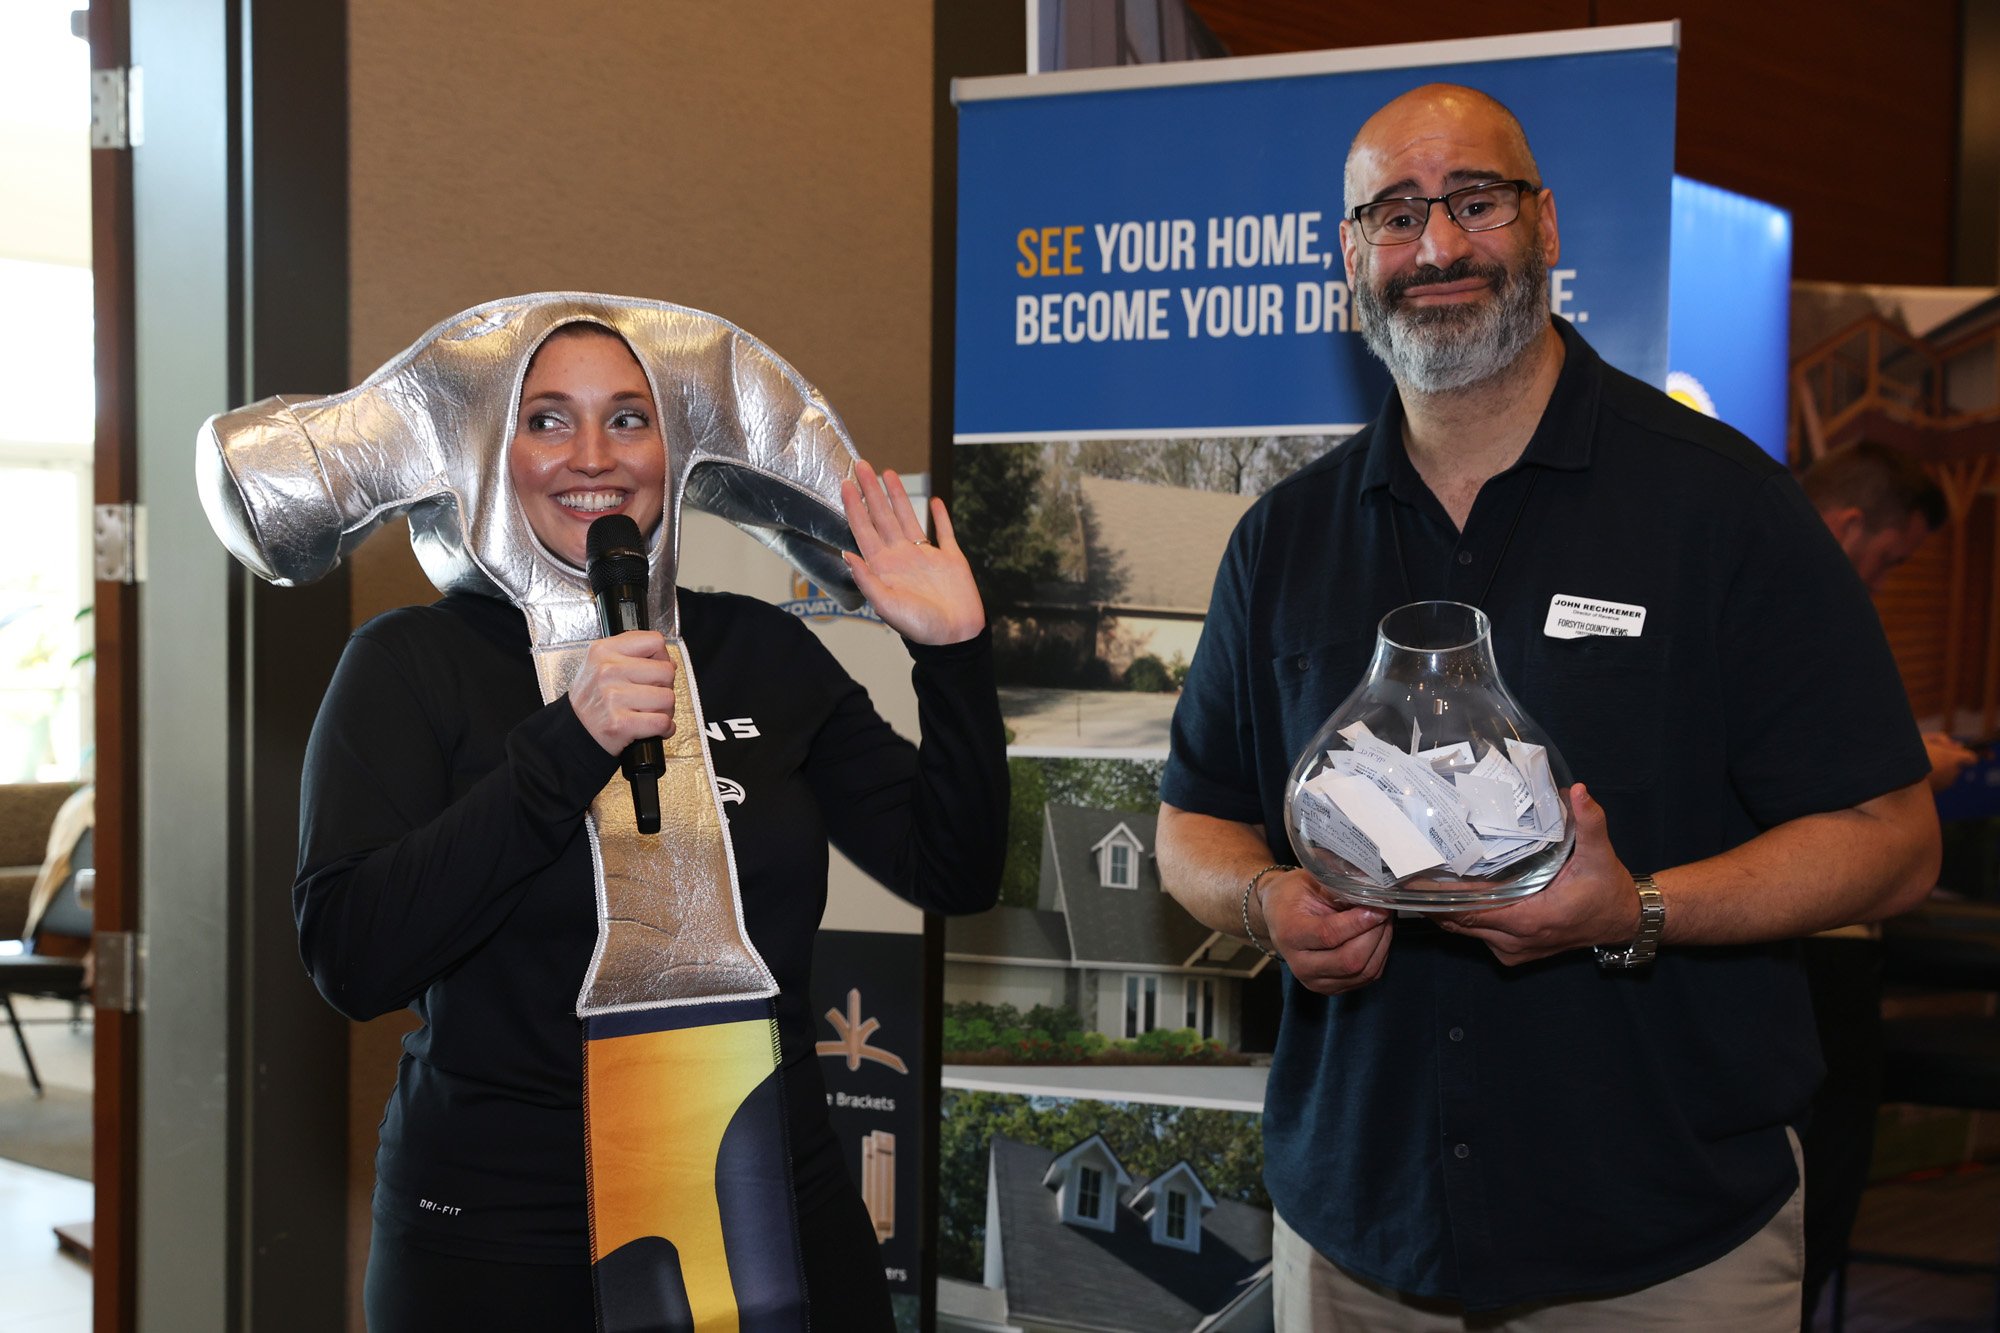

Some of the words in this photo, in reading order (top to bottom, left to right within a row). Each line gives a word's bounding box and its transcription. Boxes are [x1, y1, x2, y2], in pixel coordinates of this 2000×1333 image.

[1016, 226, 1085, 278] SEE
[1094, 219, 1196, 274] YOUR
[1207, 211, 1333, 270] HOME,
[1015, 289, 1170, 346] BECOME
[1180, 284, 1283, 339] YOUR
[1554, 600, 1581, 609] JOHN
[1583, 604, 1642, 618] RECHKEMER
[1557, 618, 1585, 630] FORSYTH
[1585, 622, 1610, 634] COUNTY
[1610, 626, 1629, 637] NEWS
[836, 1092, 896, 1112] Brackets
[419, 1199, 462, 1216] DRI-FIT
